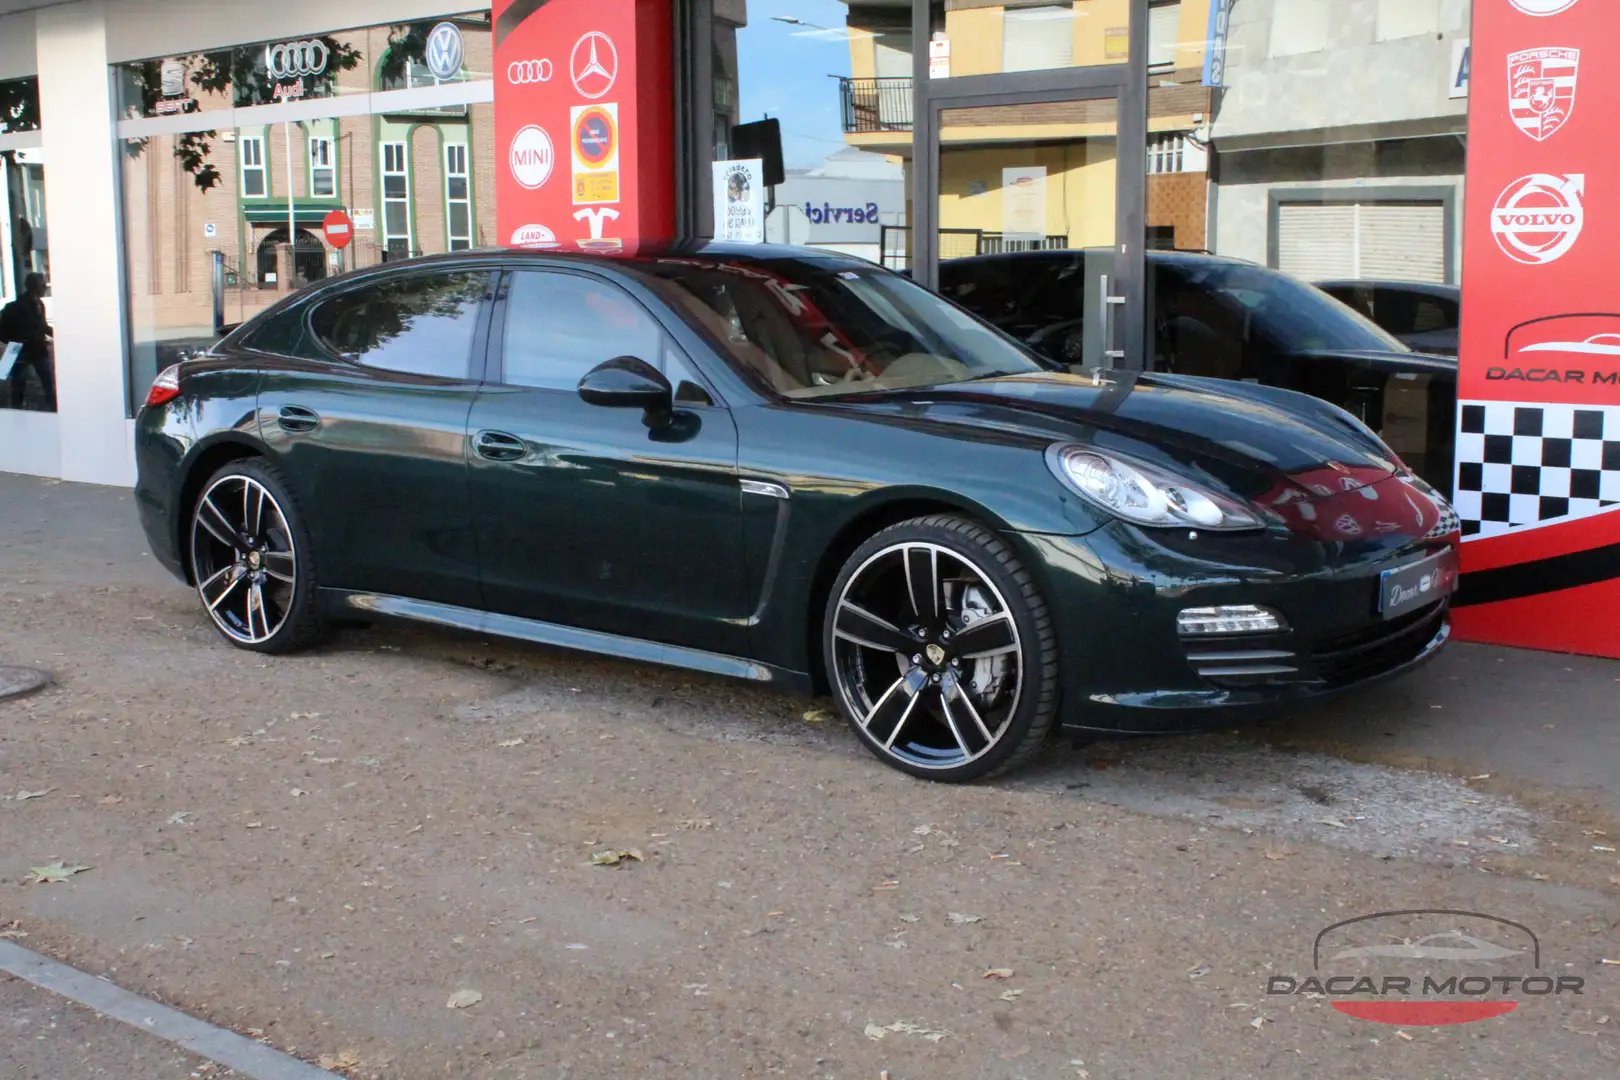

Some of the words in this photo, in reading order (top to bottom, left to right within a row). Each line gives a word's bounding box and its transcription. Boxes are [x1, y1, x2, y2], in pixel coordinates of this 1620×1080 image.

[1510, 50, 1577, 65] PORSCHE
[273, 77, 304, 99] Audi
[514, 148, 549, 166] MINI
[1497, 213, 1576, 226] VOLVO
[1485, 367, 1585, 384] DACAR
[1592, 371, 1620, 385] M
